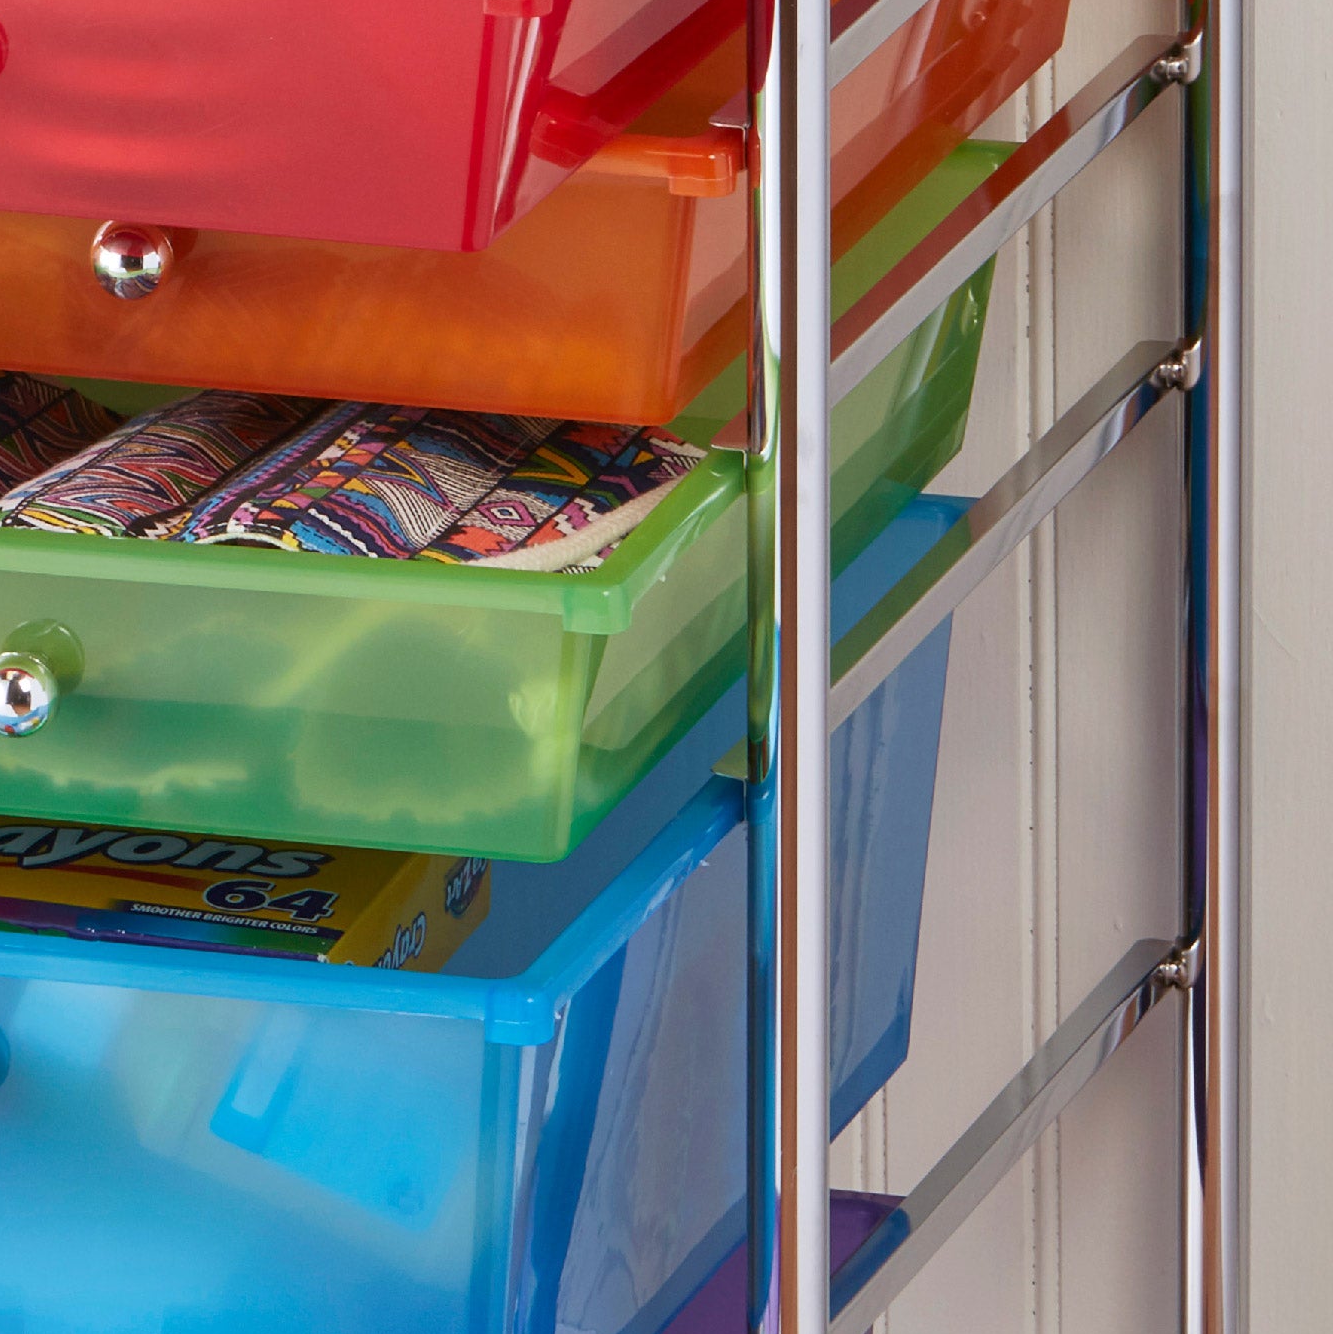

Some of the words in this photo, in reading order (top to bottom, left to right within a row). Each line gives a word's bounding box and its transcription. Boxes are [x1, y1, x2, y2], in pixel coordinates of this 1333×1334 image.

[130, 902, 202, 920] SMOOTHER
[203, 912, 269, 929] BRIGHTER
[269, 920, 319, 935] COLORS
[202, 878, 339, 922] 64
[373, 911, 427, 970] Crayo
